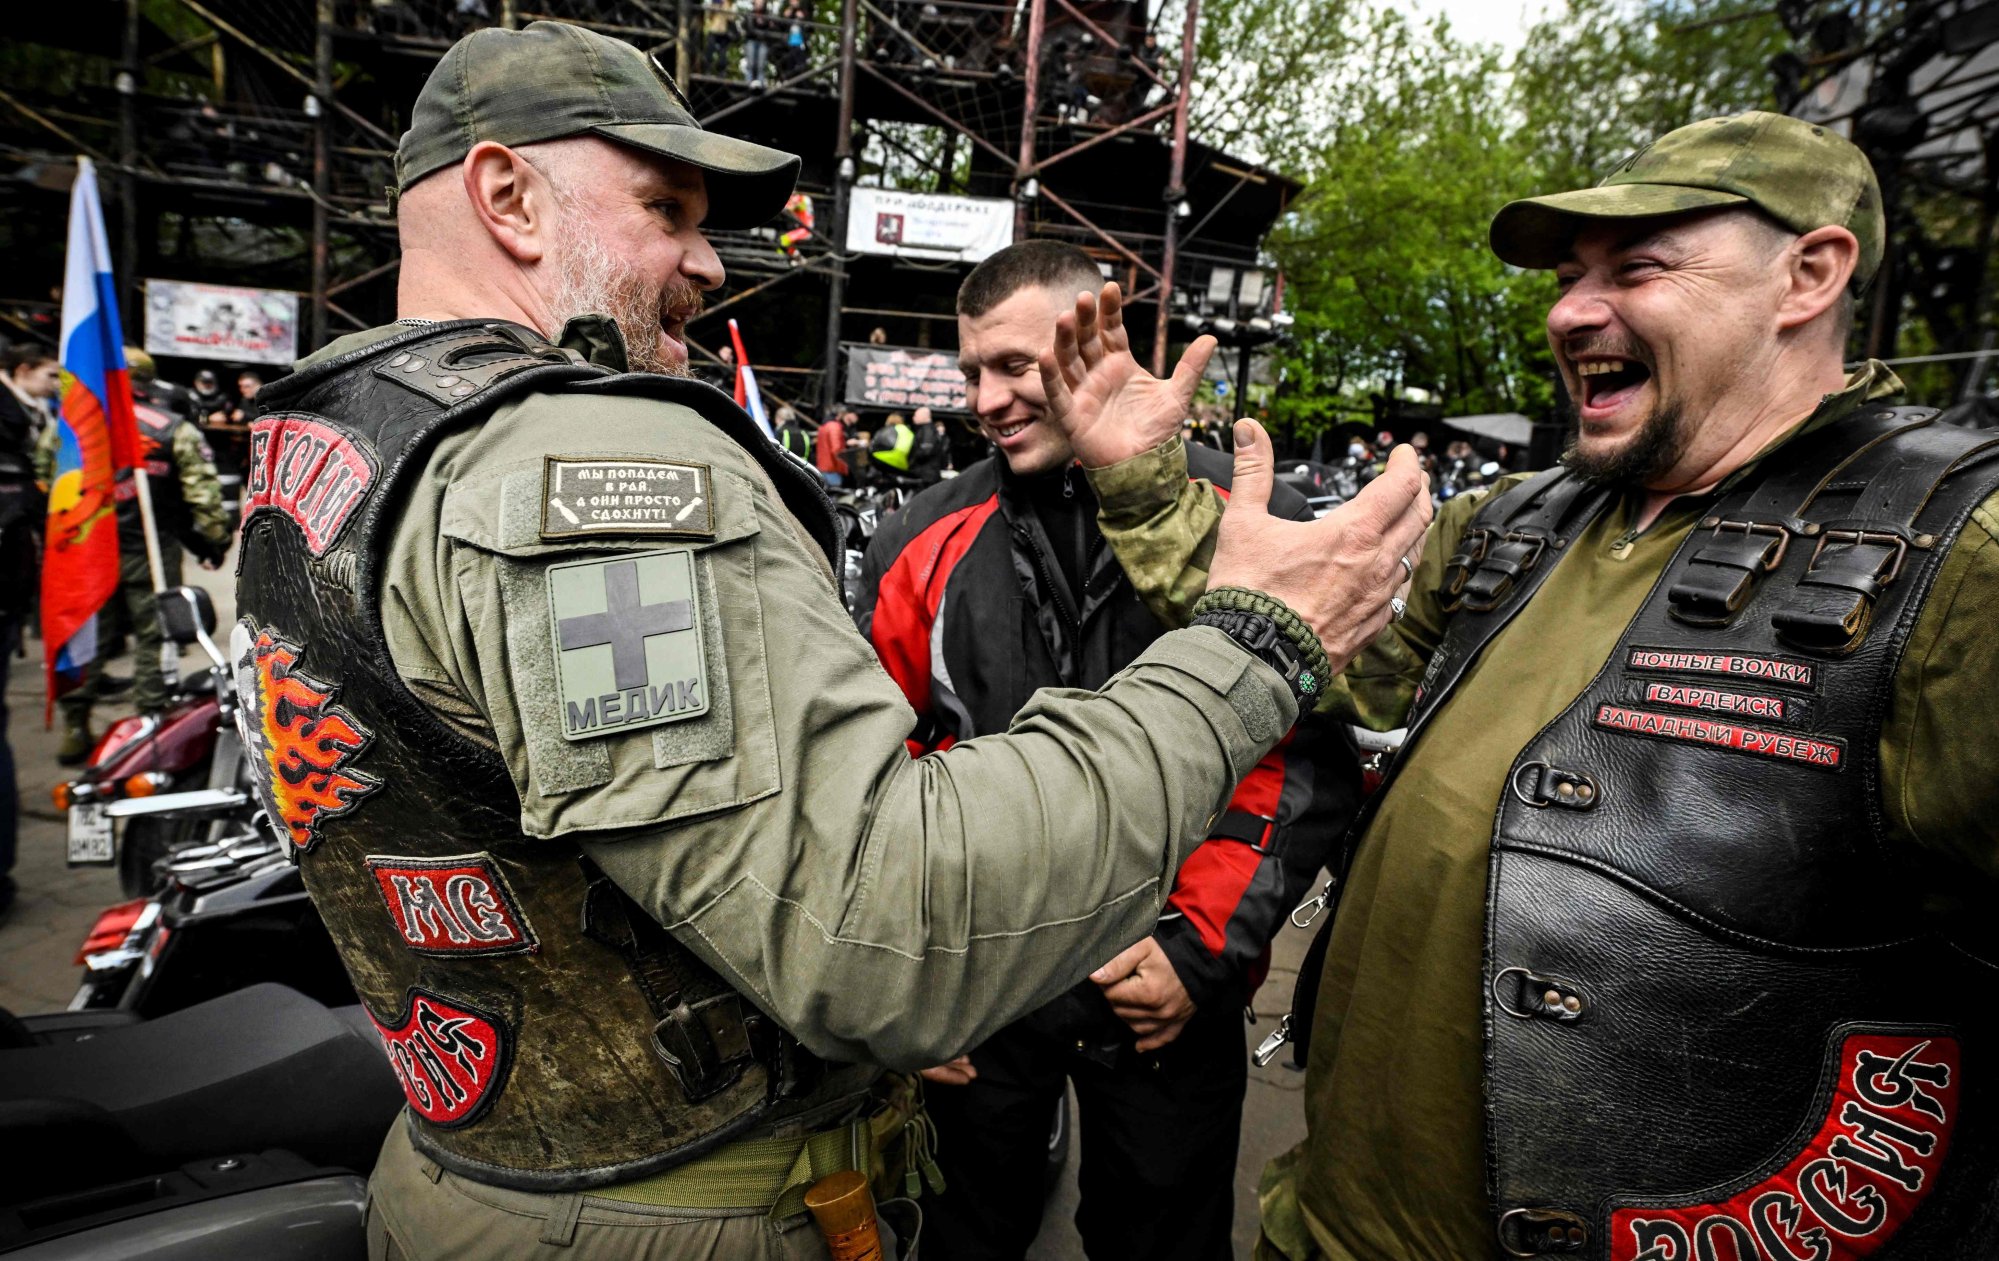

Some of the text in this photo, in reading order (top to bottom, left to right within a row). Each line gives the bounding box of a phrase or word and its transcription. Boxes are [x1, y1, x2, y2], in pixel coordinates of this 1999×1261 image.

[577, 469, 680, 481] МЫ ПОПАДЕМ
[605, 482, 614, 492] В
[576, 495, 681, 507] А ОНИ ПРОСТО
[591, 508, 667, 521] СДОХНУТ!
[1631, 651, 1812, 684] НОЧНЫЕ ВОЛКИ
[566, 677, 700, 732] МЕДИК
[1741, 731, 1837, 765] РУБЕЖ
